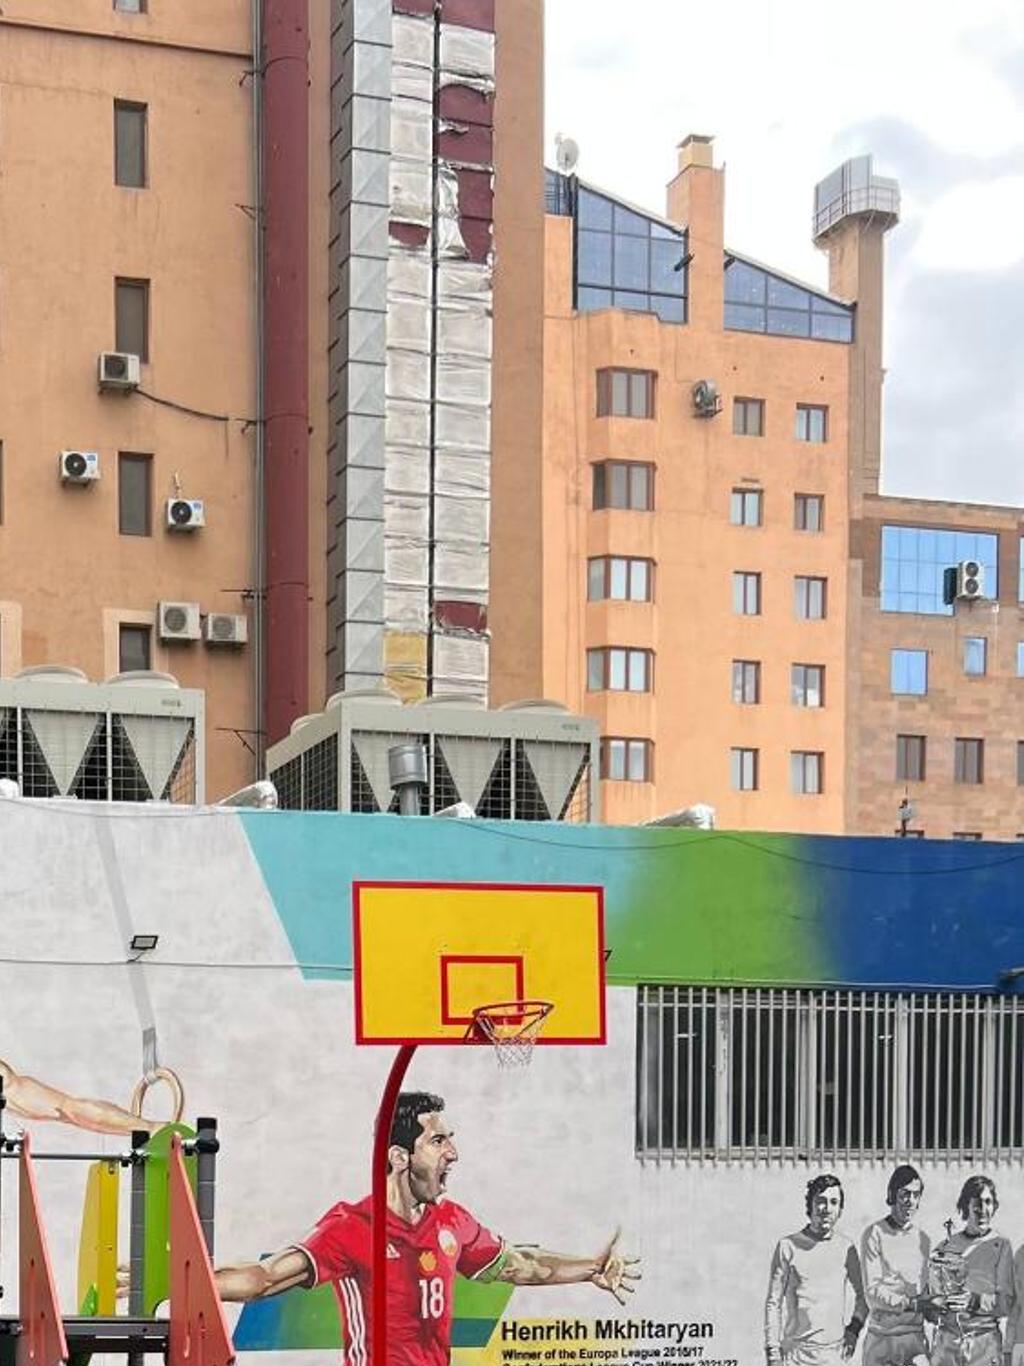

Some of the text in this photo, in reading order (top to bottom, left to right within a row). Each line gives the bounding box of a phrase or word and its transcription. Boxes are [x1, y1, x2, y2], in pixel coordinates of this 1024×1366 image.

[419, 1277, 445, 1319] 18
[501, 1319, 714, 1343] Henrikh Mkhitaryan
[502, 1348, 541, 1360] Winner
[545, 1348, 556, 1360] of
[559, 1348, 576, 1360] the
[579, 1347, 618, 1361] Europa
[621, 1346, 661, 1361] League
